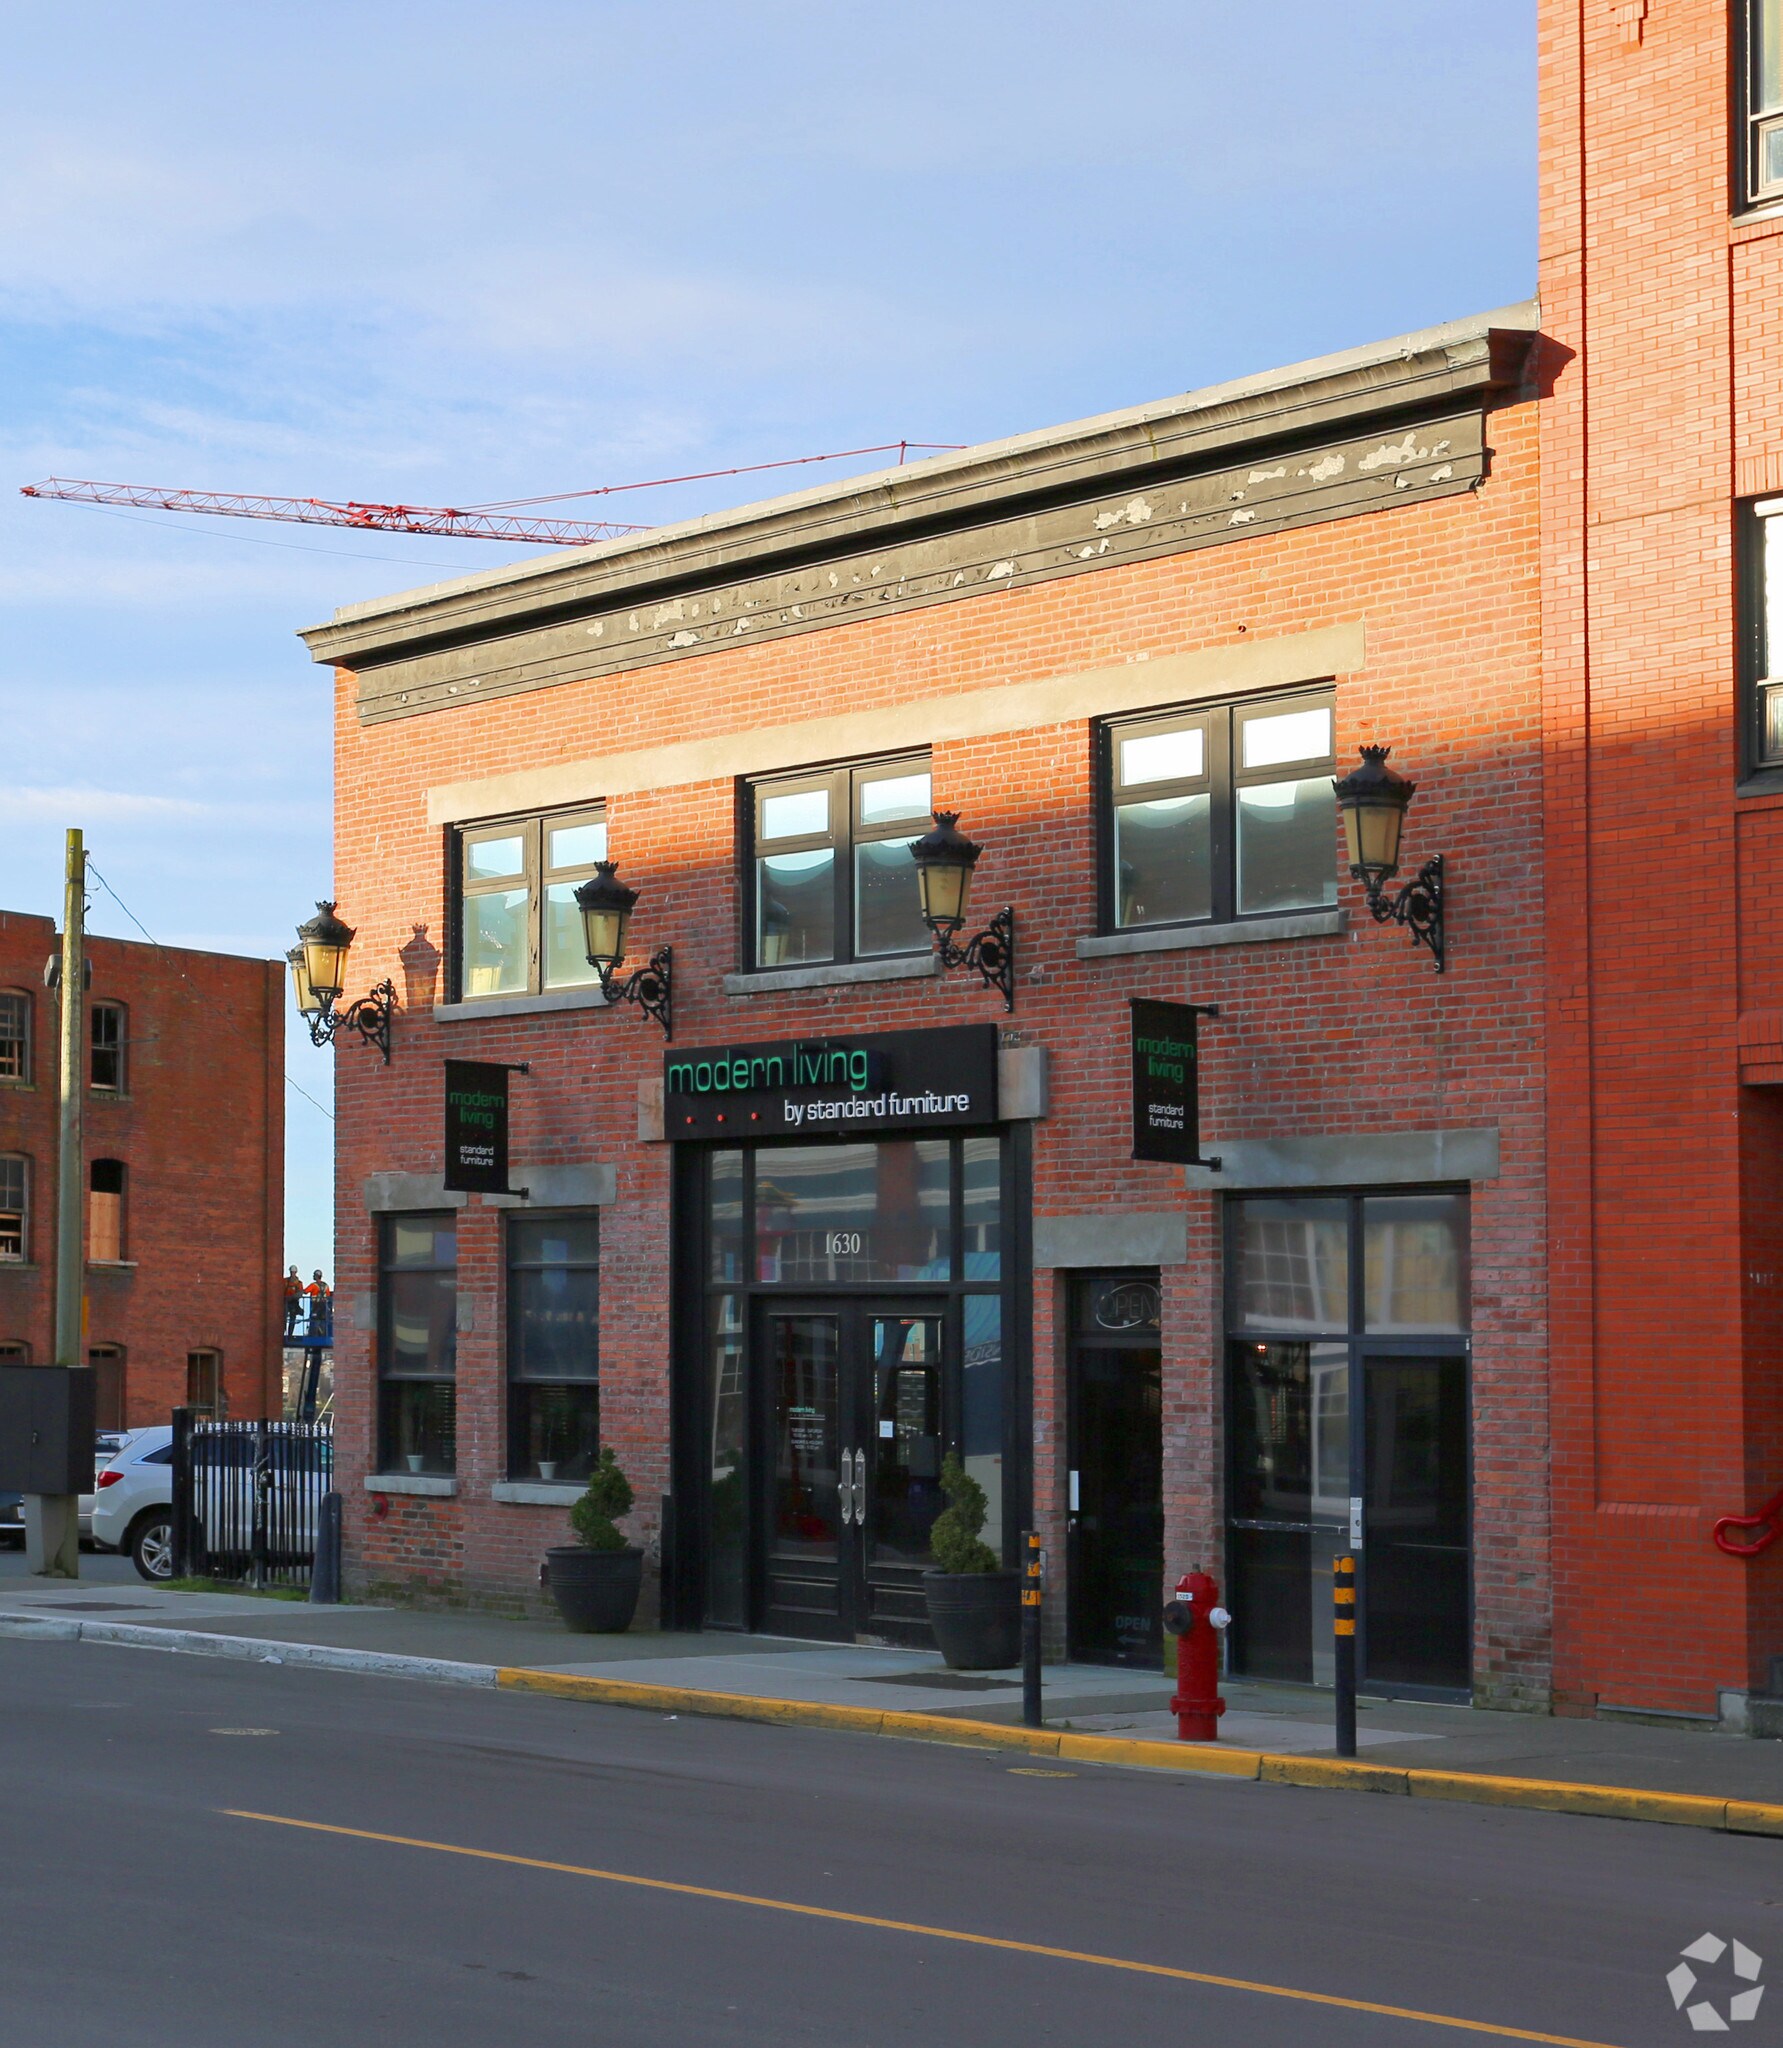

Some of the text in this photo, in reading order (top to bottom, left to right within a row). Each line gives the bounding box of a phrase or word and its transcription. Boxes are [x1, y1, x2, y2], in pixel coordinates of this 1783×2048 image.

[1137, 1036, 1195, 1059] modern
[669, 1041, 868, 1093] modern living
[1148, 1055, 1184, 1084] living
[449, 1090, 505, 1109] modern
[784, 1090, 970, 1126] by standard furniture
[1148, 1103, 1184, 1117] standard
[459, 1106, 494, 1129] living
[1149, 1114, 1184, 1129] furniture
[459, 1144, 494, 1156] standard
[460, 1154, 494, 1166] furniture
[825, 1232, 861, 1254] 1630
[1098, 1292, 1158, 1319] OPEN
[1115, 1615, 1151, 1632] OPEN
